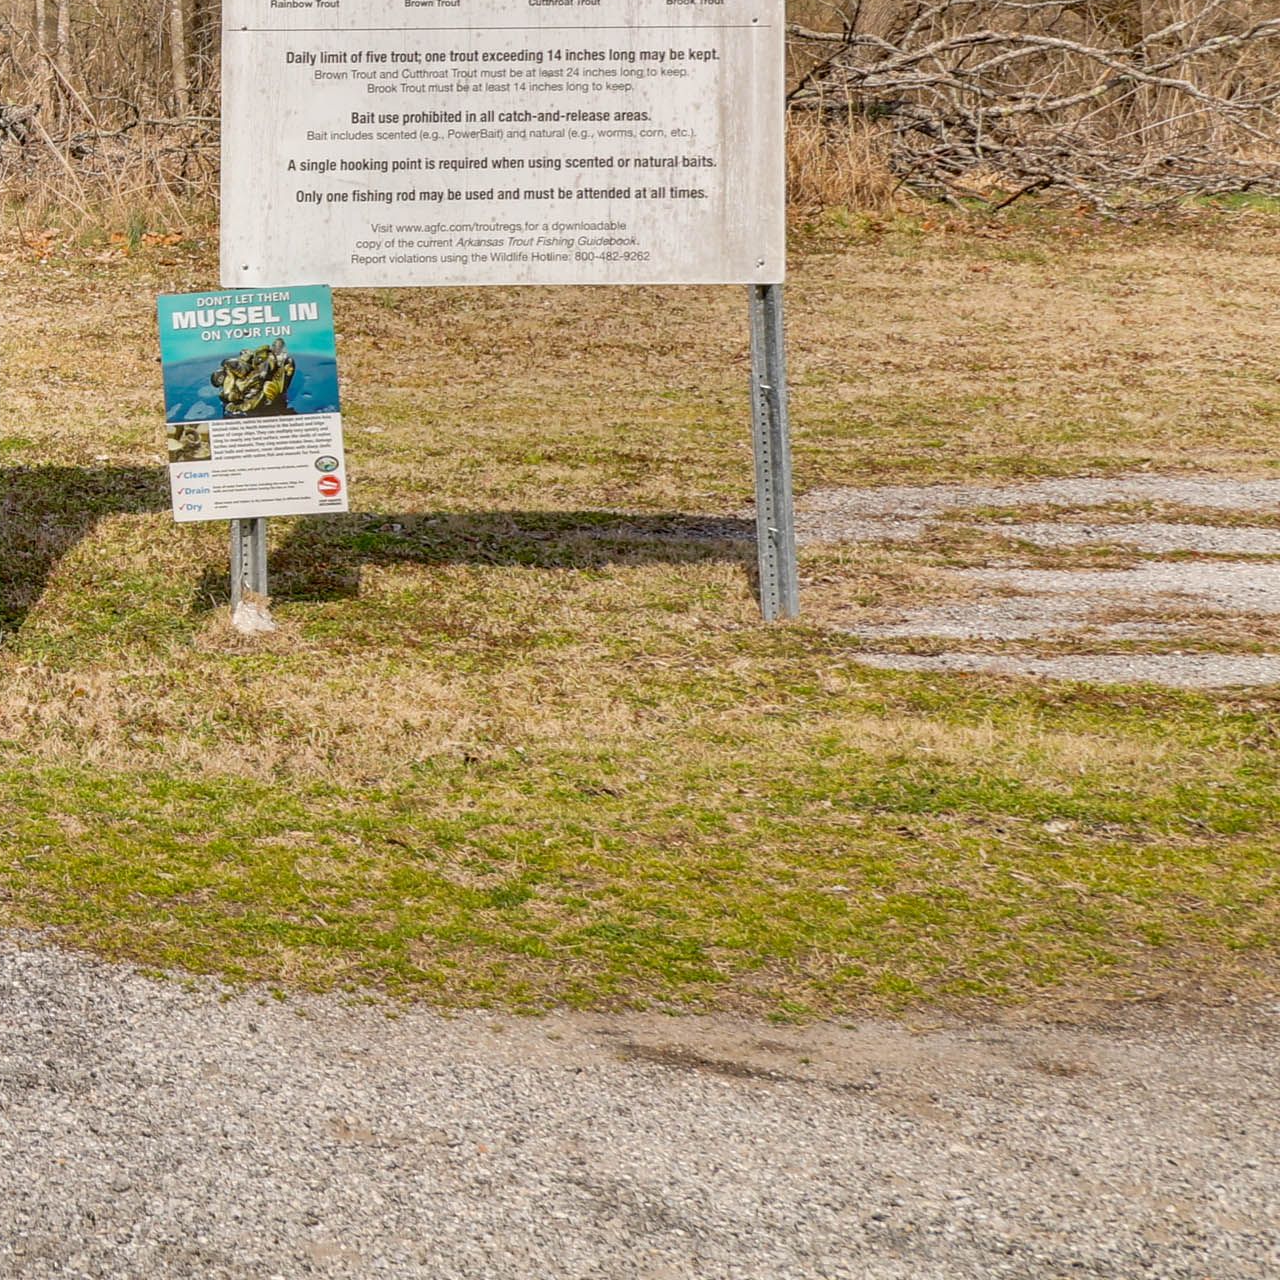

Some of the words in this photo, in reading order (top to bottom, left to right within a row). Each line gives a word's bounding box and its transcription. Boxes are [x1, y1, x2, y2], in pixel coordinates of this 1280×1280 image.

[286, 51, 316, 66] Daily
[320, 51, 347, 64] limit
[350, 51, 363, 63] of
[366, 51, 387, 63] five
[390, 51, 422, 64] trout;
[425, 52, 446, 62] one
[449, 50, 479, 62] trout
[482, 50, 543, 63] exceeding
[548, 50, 562, 61] 14
[565, 49, 605, 61] inches
[609, 48, 635, 63] long
[639, 50, 665, 63] may
[669, 48, 685, 60] be
[688, 48, 720, 63] kept.
[314, 70, 348, 80] Brown
[351, 70, 377, 79] Trout
[380, 69, 398, 79] and
[401, 69, 449, 79] Cutthroat
[451, 69, 477, 79] Trout
[480, 69, 506, 78] must
[509, 68, 523, 78] be
[526, 68, 536, 78] at
[539, 68, 563, 78] least
[566, 68, 580, 77] 24
[583, 67, 617, 77] inches
[620, 67, 644, 79] long
[646, 68, 657, 77] to
[660, 67, 690, 79] keep.
[367, 84, 397, 93] Brook
[401, 83, 426, 93] Trout
[428, 84, 453, 93] must
[456, 83, 470, 92] be
[472, 83, 483, 92] at
[485, 83, 510, 92] least
[514, 82, 526, 91] 14
[529, 81, 563, 91] inches
[566, 81, 589, 93] long
[592, 82, 603, 91] to
[606, 81, 634, 92] keep.
[351, 112, 375, 124] Bait
[378, 113, 398, 124] use
[402, 111, 462, 125] prohibited
[465, 111, 477, 123] in
[480, 110, 495, 122] all
[498, 110, 610, 122] catch-and-release
[614, 111, 651, 121] areas.
[288, 159, 296, 171] A
[299, 159, 337, 173] single
[340, 158, 388, 173] hooking
[392, 158, 422, 172] point
[425, 158, 435, 169] is
[439, 157, 488, 172] required
[492, 157, 524, 169] when
[528, 156, 561, 170] using
[565, 156, 614, 168] scented
[617, 158, 630, 168] or
[634, 155, 678, 167] natural
[682, 155, 717, 168] baits.
[296, 190, 322, 205] Only
[326, 192, 348, 202] one
[352, 189, 393, 204] fishing
[396, 189, 416, 201] rod
[419, 191, 444, 203] may
[447, 189, 462, 200] be
[465, 188, 494, 200] used
[497, 188, 520, 200] and
[524, 188, 554, 199] must
[558, 187, 573, 199] be
[576, 187, 631, 199] attended
[634, 187, 647, 198] at
[650, 187, 665, 198] all
[669, 187, 708, 199] times.
[356, 240, 381, 250] copy
[384, 239, 395, 248] of
[398, 239, 414, 248] the
[416, 239, 453, 248] current
[455, 238, 504, 247] Arkansas
[508, 237, 534, 246] Trout
[536, 236, 574, 248] Fishing
[351, 255, 386, 265] Report
[389, 254, 438, 263] violations
[440, 254, 468, 265] using
[471, 253, 488, 262] the
[490, 252, 528, 262] Wildlife
[196, 294, 231, 307] DON'T
[235, 292, 254, 305] LET
[258, 291, 291, 303] THEM
[172, 305, 280, 330] MUSSEL
[289, 302, 318, 321] IN
[201, 330, 221, 341] ON
[224, 327, 261, 339] YOUR
[265, 325, 291, 337] FUN
[183, 470, 209, 480] Clean
[184, 486, 210, 495] Drain
[186, 502, 203, 512] Dry
